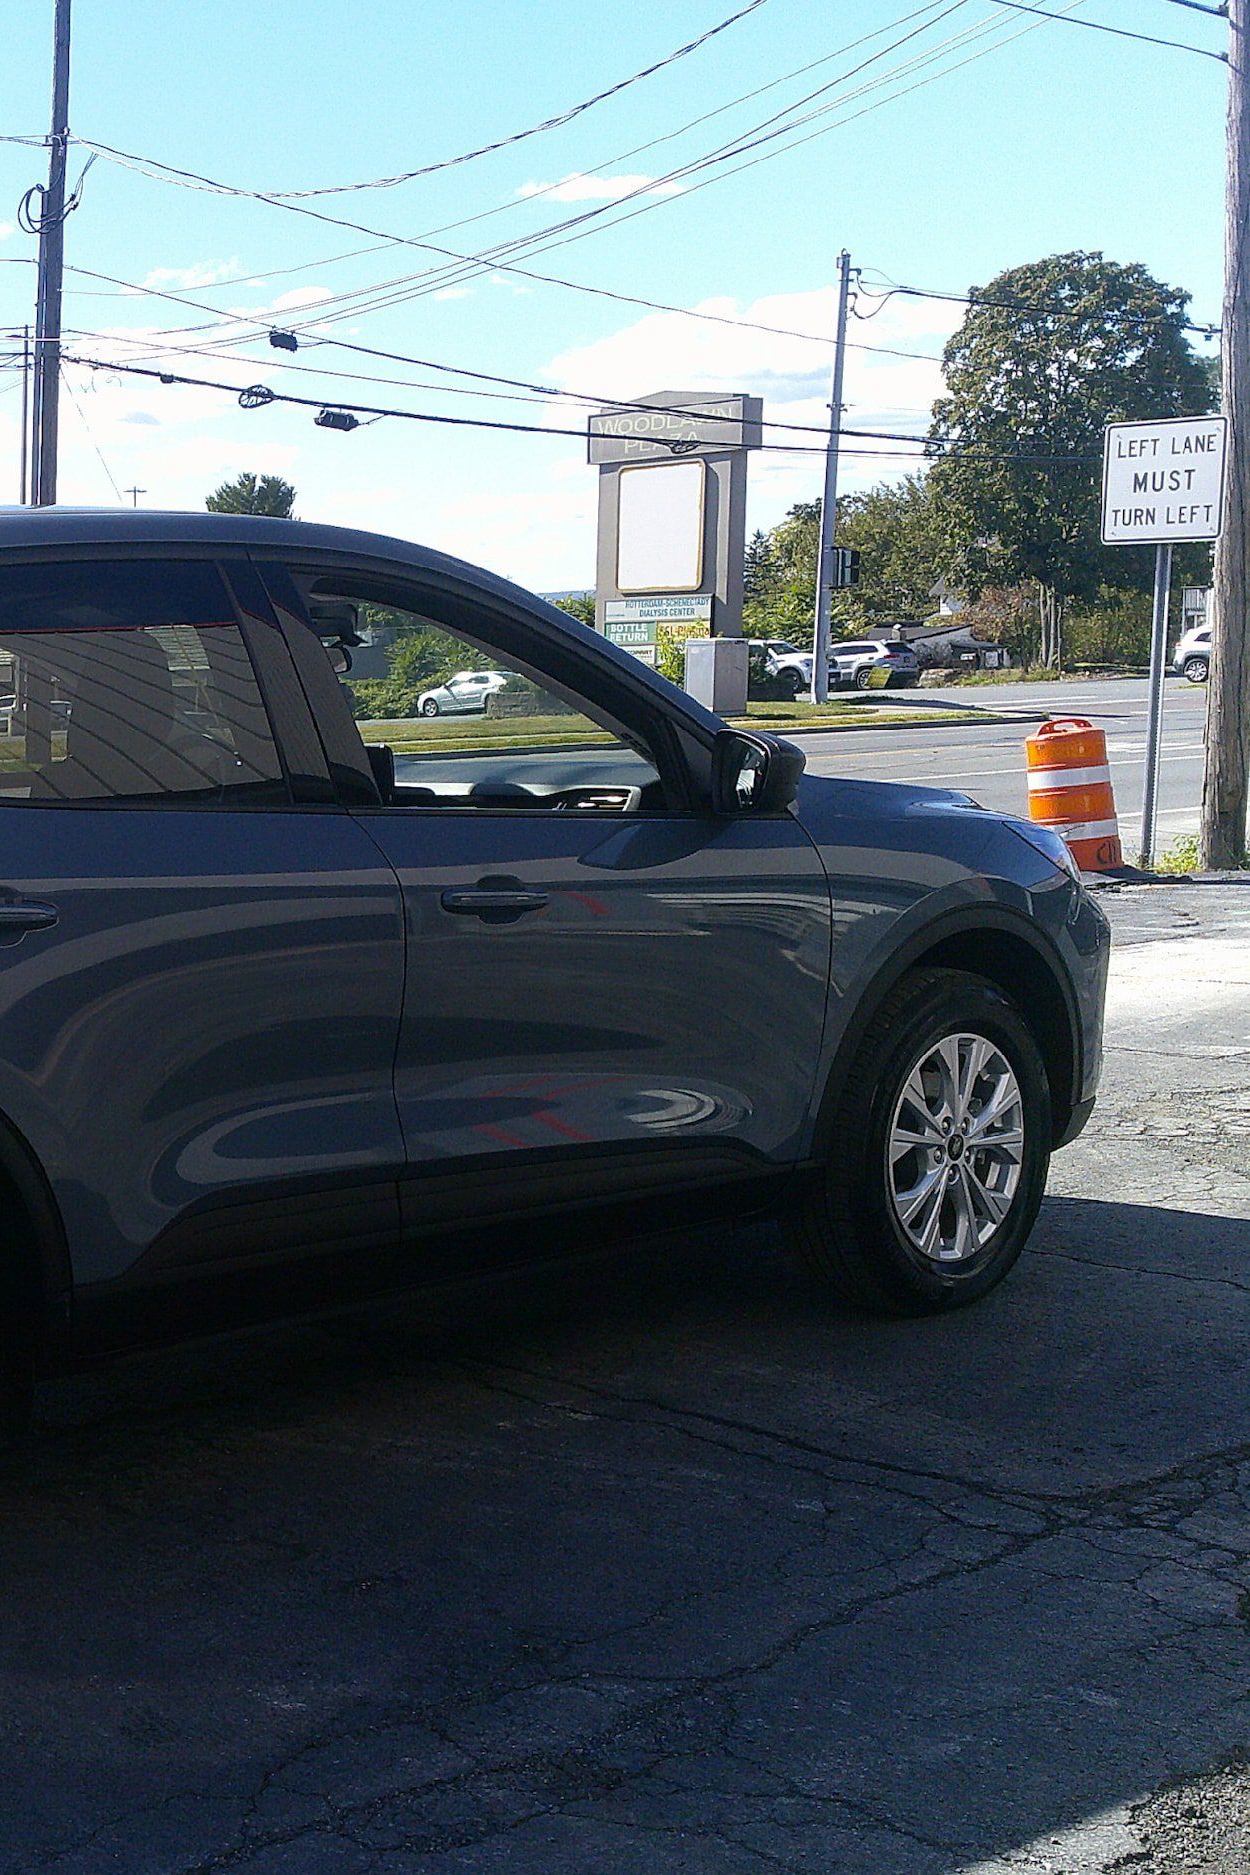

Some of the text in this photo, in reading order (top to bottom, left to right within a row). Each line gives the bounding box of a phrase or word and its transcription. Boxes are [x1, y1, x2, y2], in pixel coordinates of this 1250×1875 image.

[1117, 433, 1217, 459] LEFT LANE
[1132, 468, 1196, 493] MUST
[1111, 504, 1213, 527] TURN LEFT
[639, 607, 695, 618] DIALYSIS CENTER
[610, 623, 647, 633] BOTTLE
[610, 632, 648, 642] RETURN
